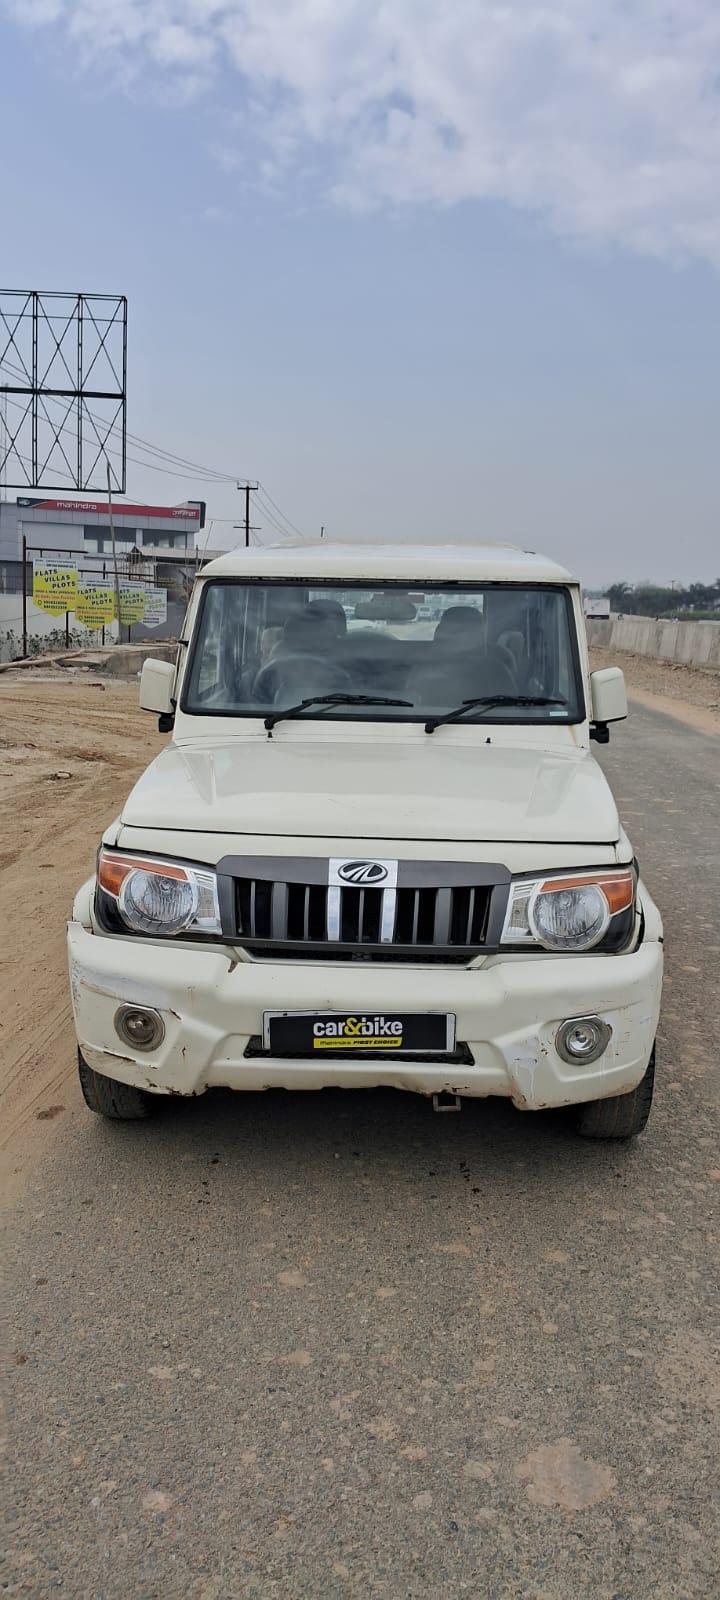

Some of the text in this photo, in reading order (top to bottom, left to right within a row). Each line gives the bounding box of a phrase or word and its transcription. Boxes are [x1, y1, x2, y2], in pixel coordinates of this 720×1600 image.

[56, 502, 97, 510] mahindra
[35, 569, 58, 577] FLATS
[45, 574, 70, 582] VILLAS
[52, 581, 75, 589] PLOTS
[313, 1016, 403, 1036] car&bike
